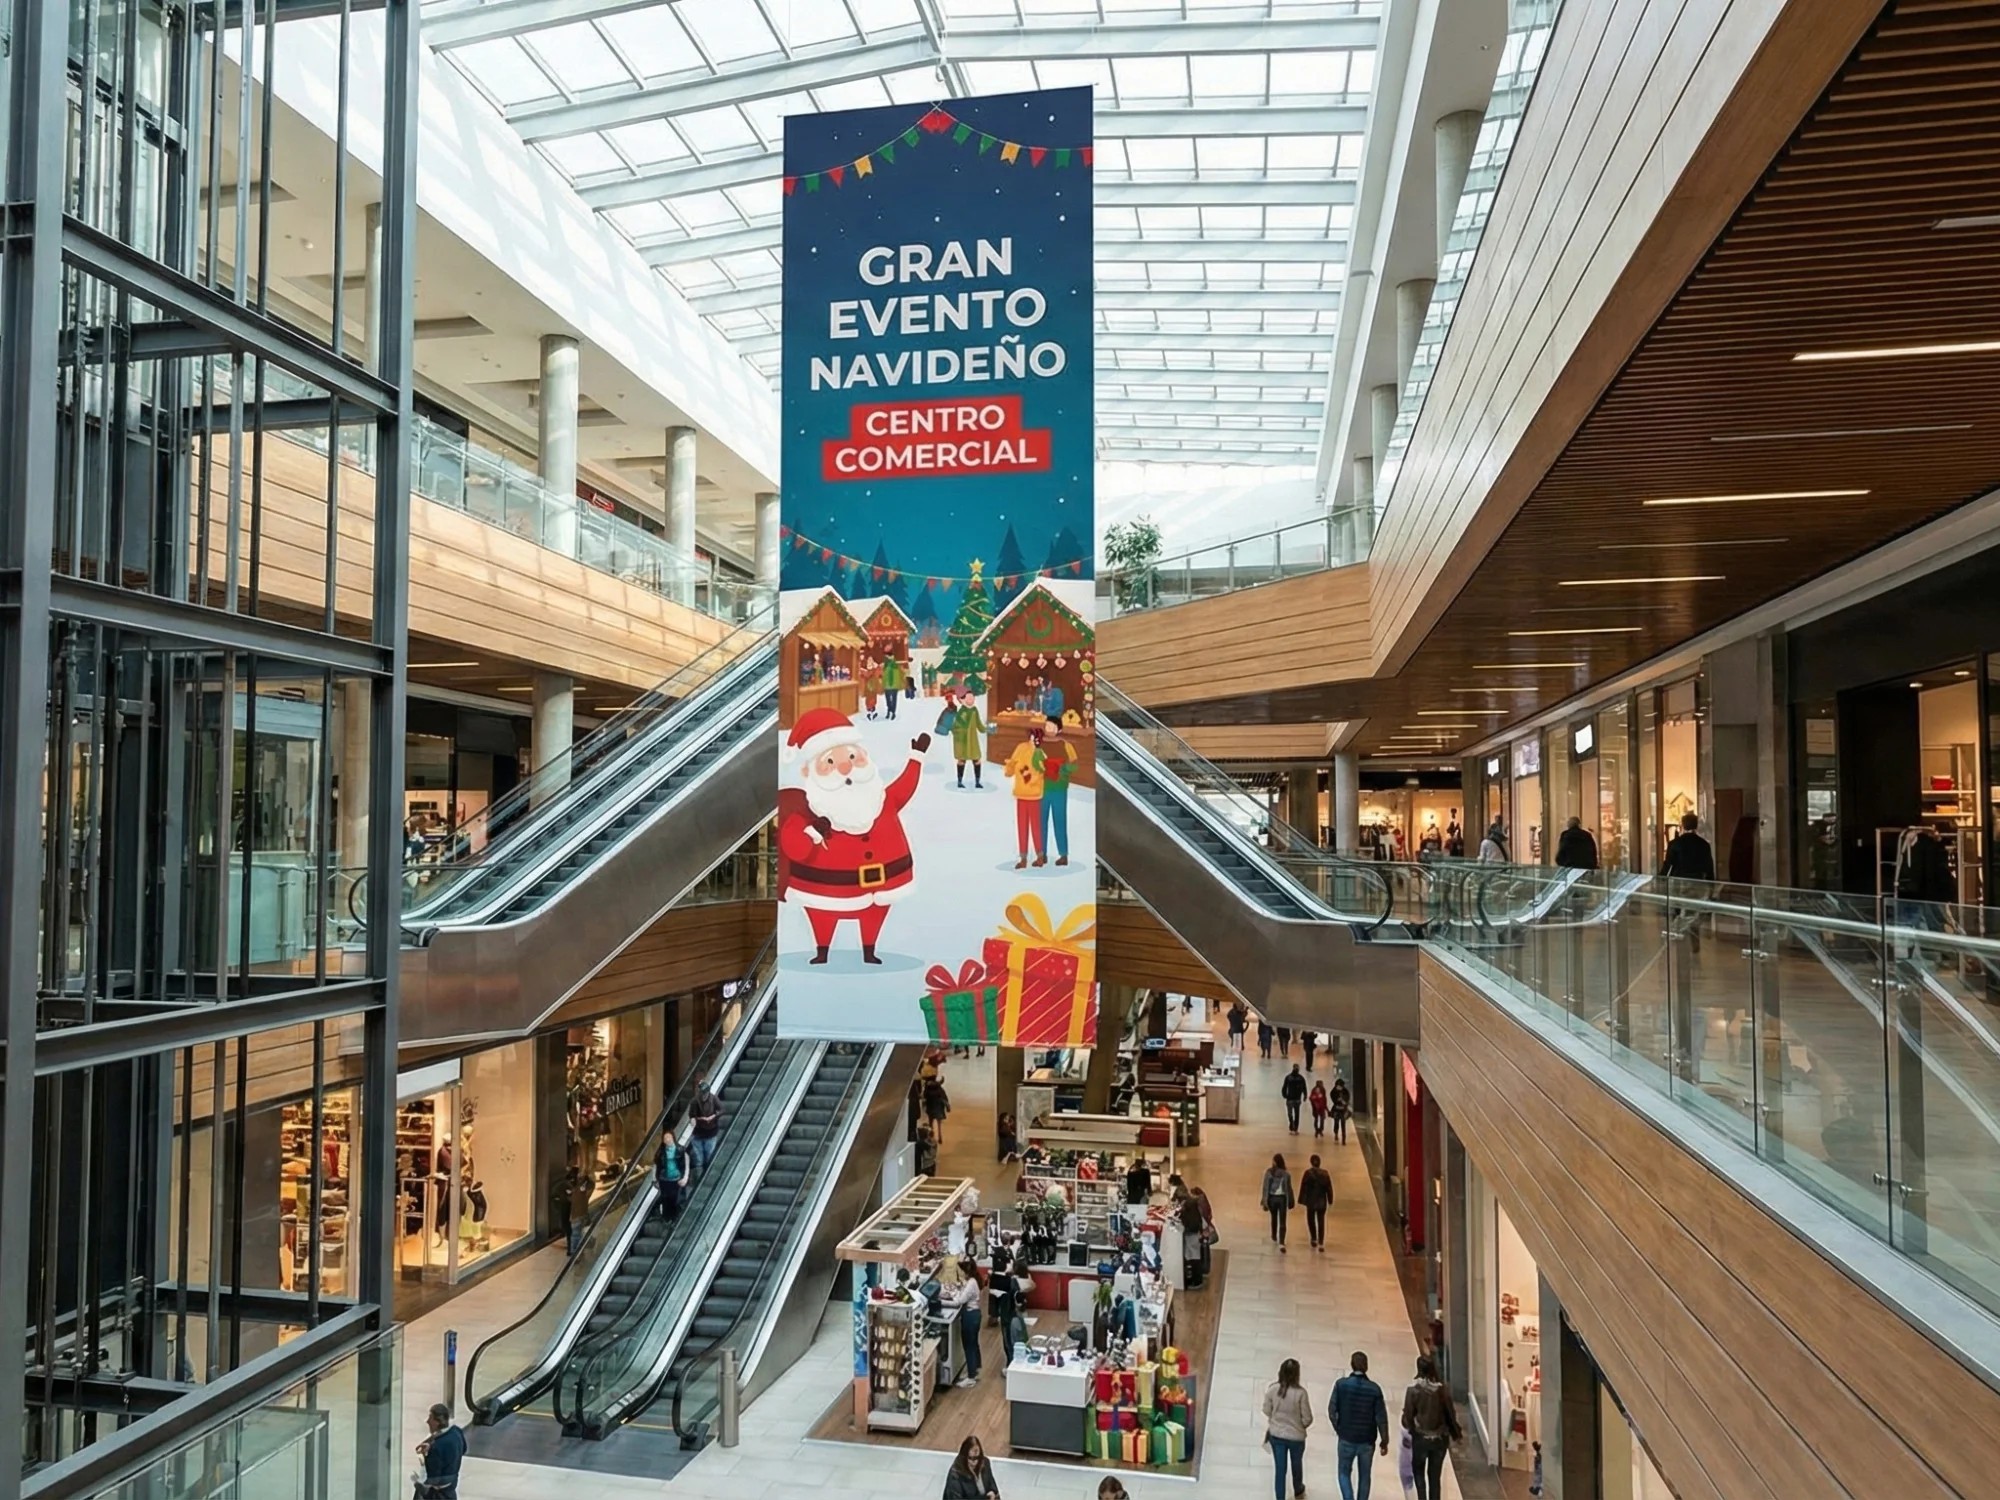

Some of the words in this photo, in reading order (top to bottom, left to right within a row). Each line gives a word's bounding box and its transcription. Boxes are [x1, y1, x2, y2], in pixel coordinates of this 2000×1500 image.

[859, 237, 1012, 286] GRAN
[830, 287, 1046, 339] EVENTO
[810, 335, 1066, 391] NAVIDEÑO
[866, 404, 1005, 436] CENTRO
[835, 439, 1037, 472] COMERCIAL
